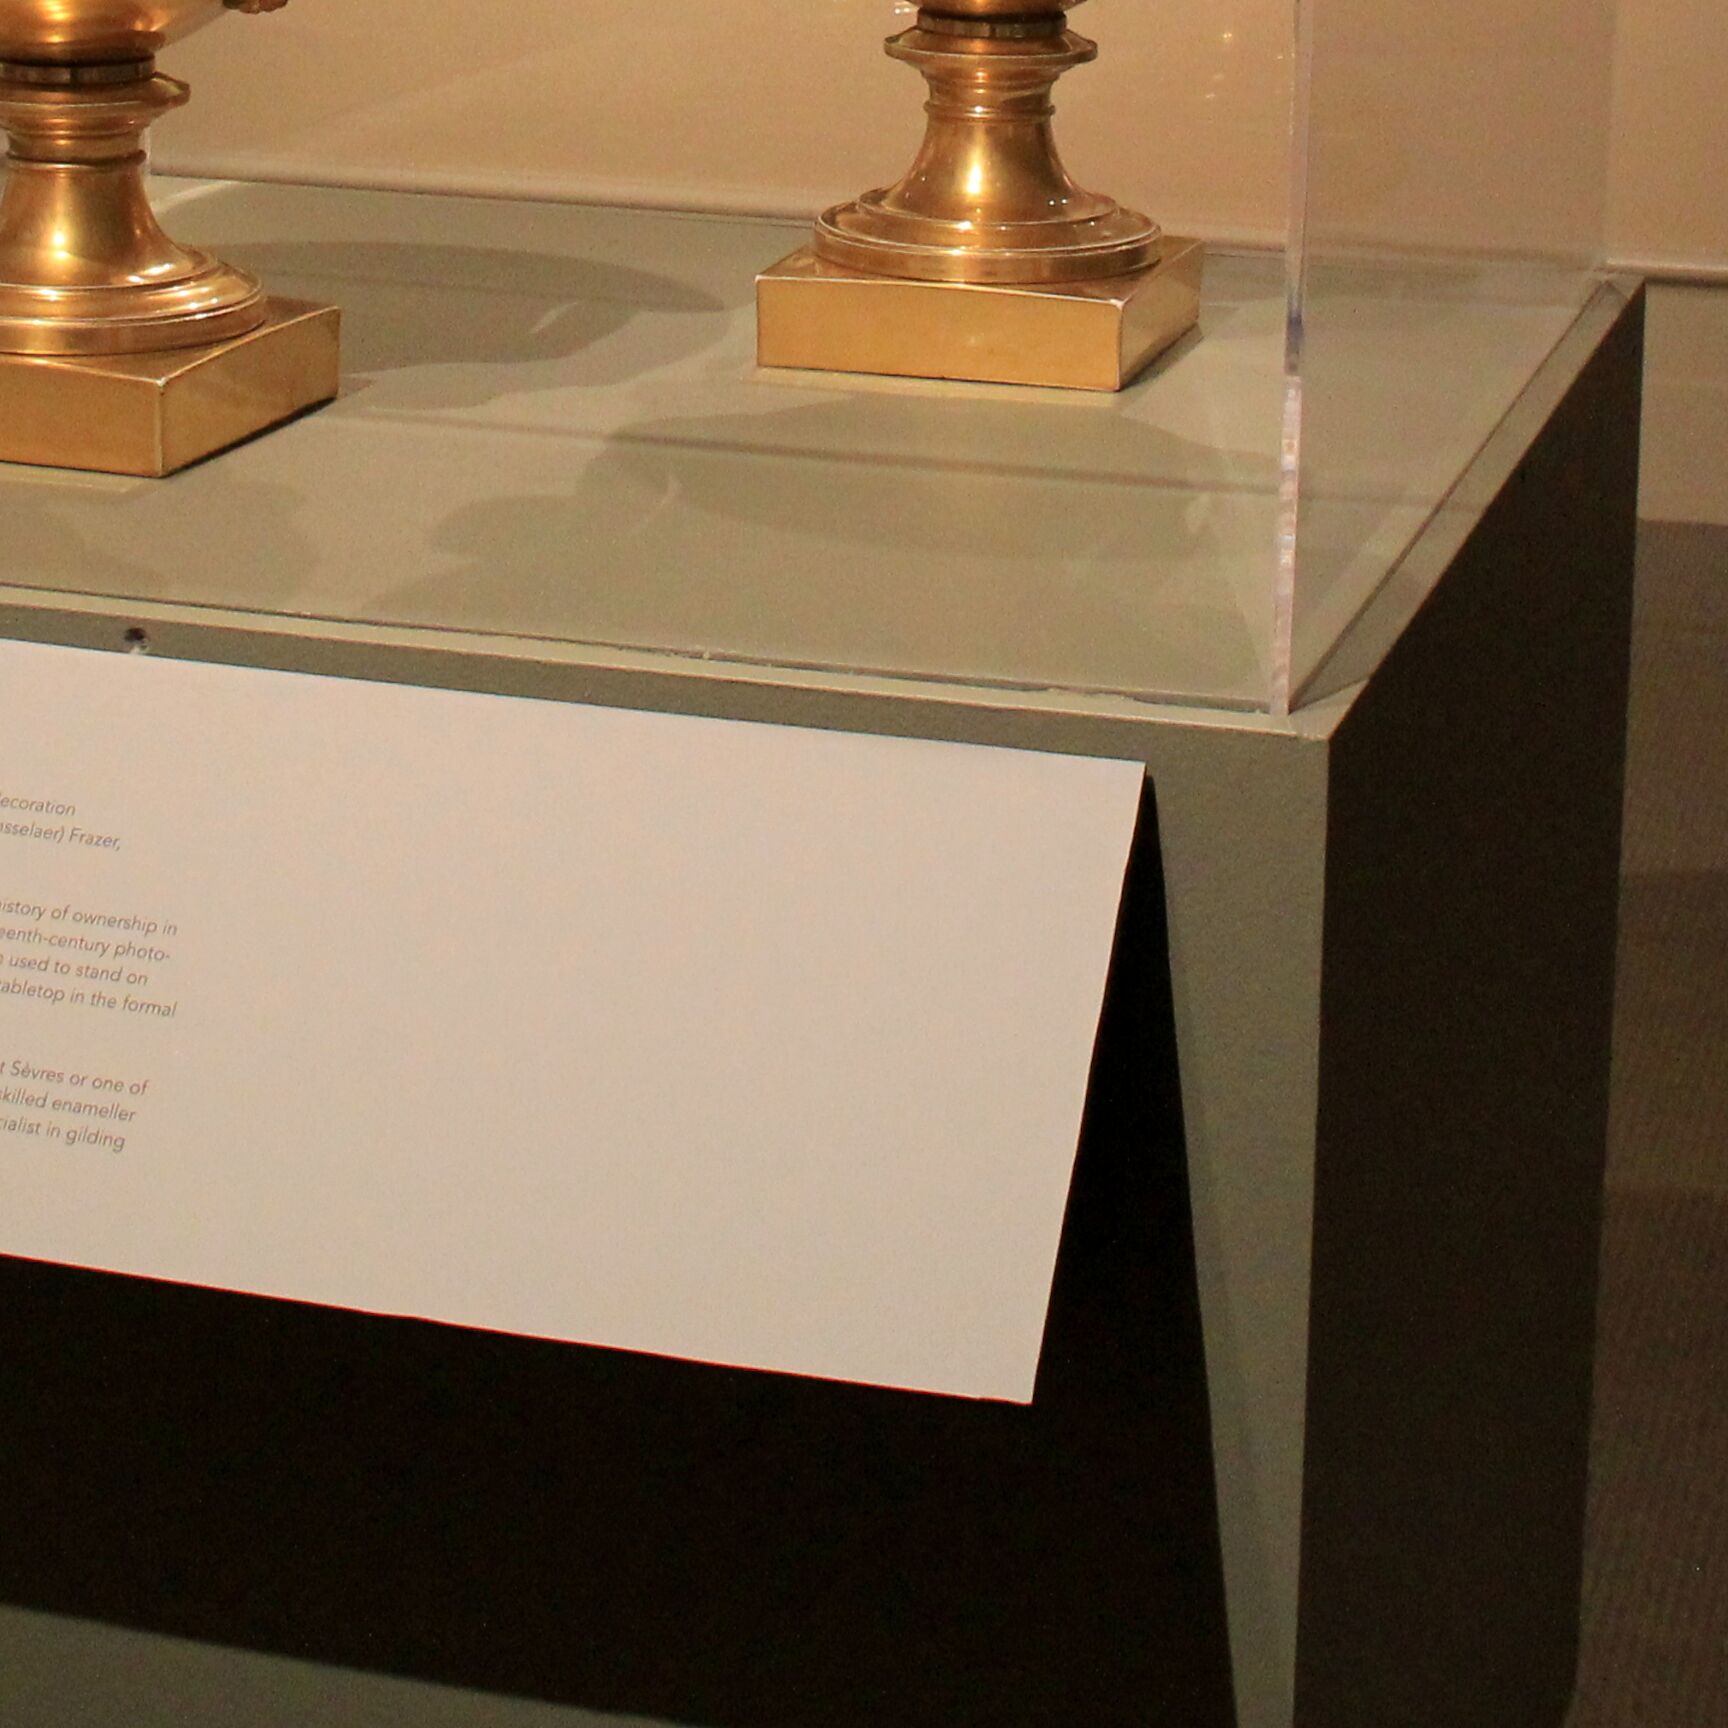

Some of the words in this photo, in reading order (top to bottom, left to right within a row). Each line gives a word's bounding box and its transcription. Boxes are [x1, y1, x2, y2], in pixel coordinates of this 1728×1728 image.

[69, 827, 121, 852] Frazer,
[51, 905, 71, 921] of
[73, 912, 158, 939] ownership
[163, 920, 178, 936] in
[113, 941, 170, 963] photo-
[9, 955, 51, 973] used
[54, 960, 71, 976] to
[76, 965, 124, 984] stand
[126, 973, 149, 987] on
[70, 988, 85, 1004] in
[90, 991, 117, 1010] the
[123, 994, 178, 1018] formal
[70, 1074, 89, 1087] or
[92, 1078, 125, 1094] one
[130, 1080, 150, 1096] of
[52, 1100, 137, 1122] enameller
[47, 1122, 61, 1139] in
[65, 1126, 126, 1154] gilding
